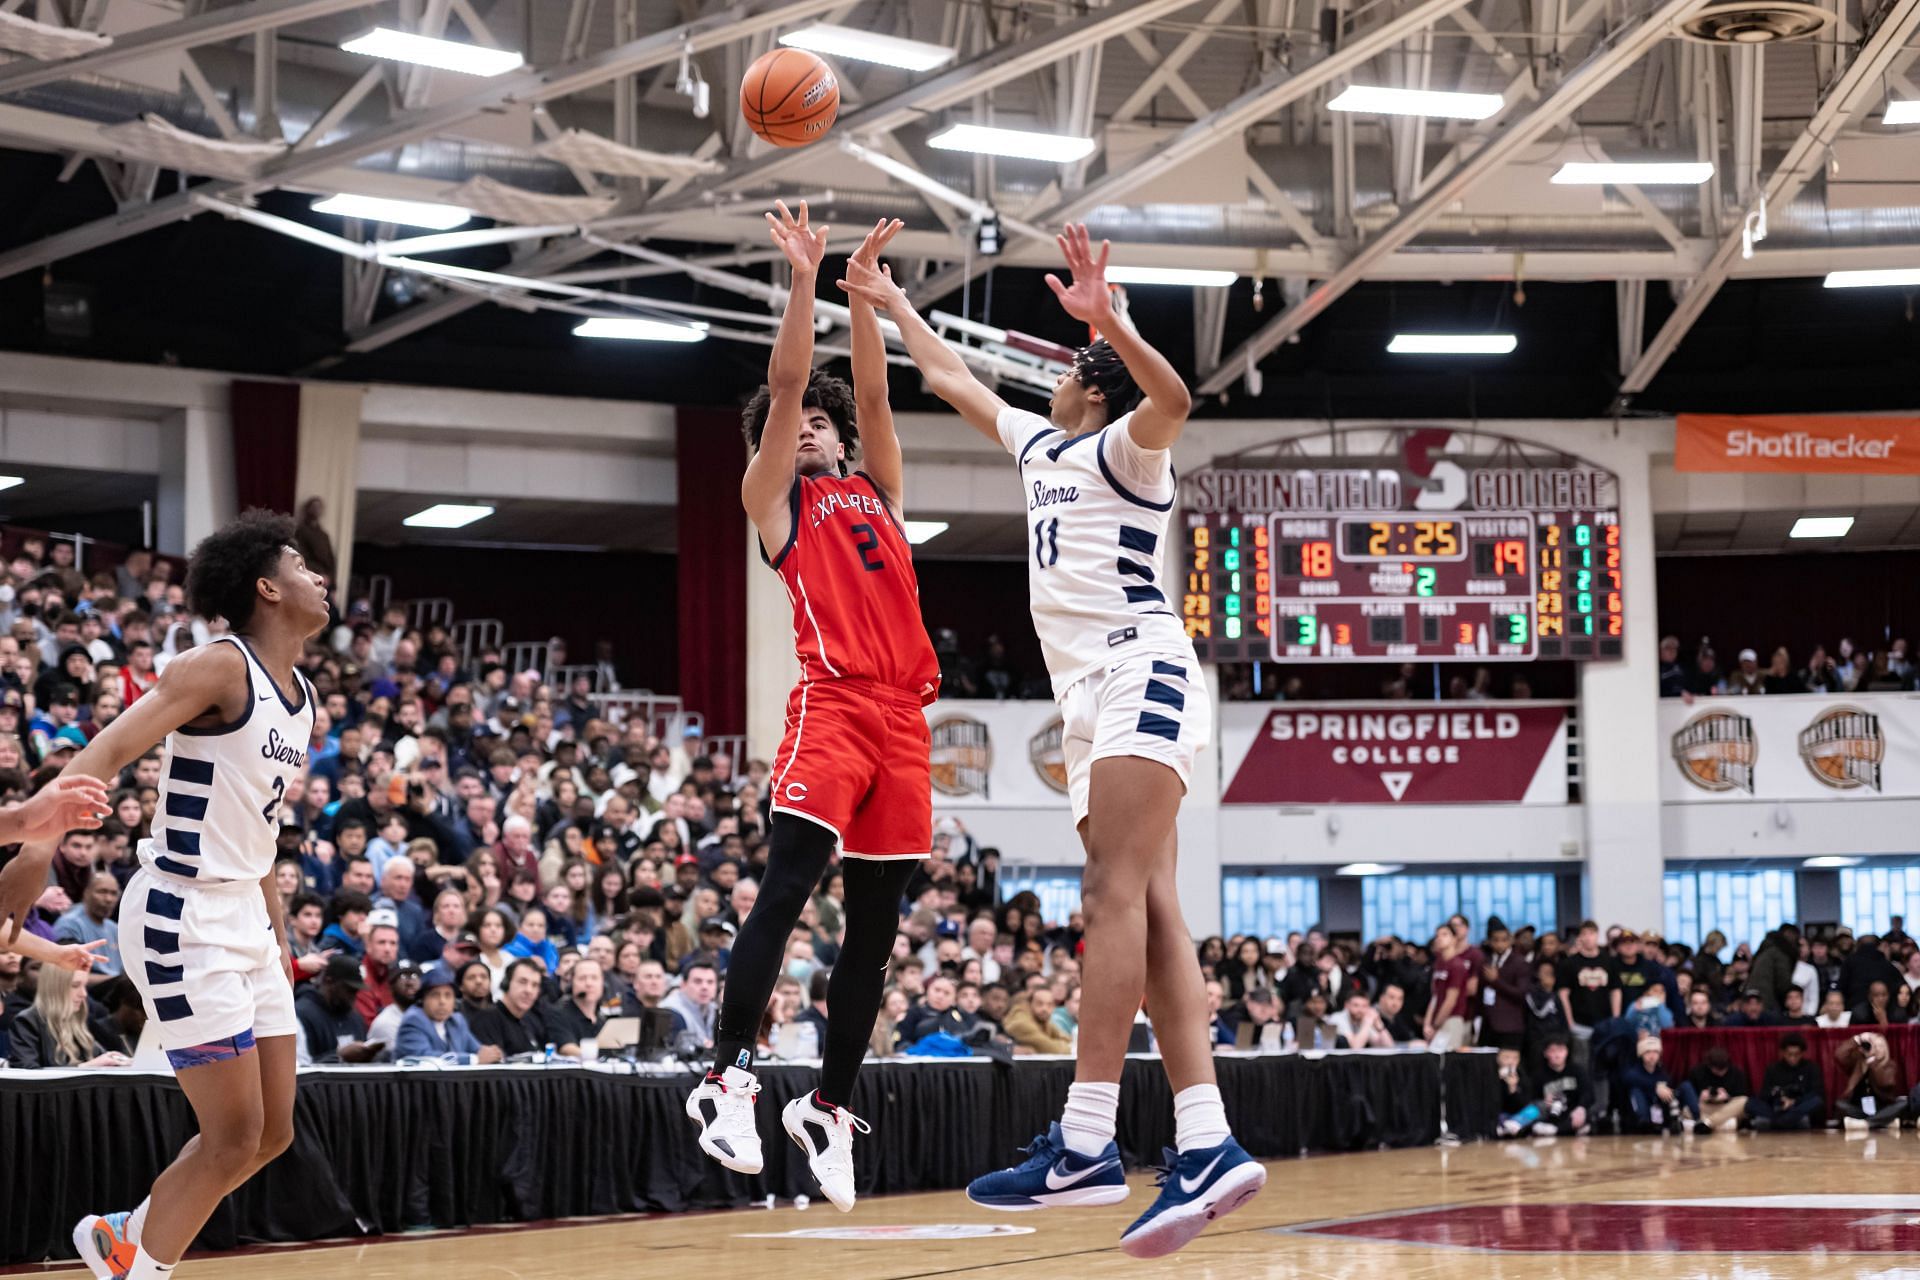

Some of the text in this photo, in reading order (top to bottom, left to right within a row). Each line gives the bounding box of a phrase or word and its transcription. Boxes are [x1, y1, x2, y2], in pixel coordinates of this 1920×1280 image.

[1726, 430, 1896, 458] ShotTracker
[1030, 480, 1079, 511] Sierra
[1193, 468, 1610, 513] SPRINGFIELD COLLEGE
[1369, 521, 1457, 556] 2:25
[1467, 519, 1529, 537] VISITOR
[1546, 525, 1560, 546] 2
[1575, 524, 1590, 546] 0
[1606, 525, 1620, 546] 2
[851, 523, 885, 571] 2
[1035, 517, 1058, 569] 11
[1195, 549, 1209, 570] 2
[1255, 549, 1269, 570] 5
[1301, 542, 1332, 577] 18
[1494, 541, 1525, 576] 19
[1541, 548, 1561, 568] 11
[1583, 548, 1591, 568] 1
[1606, 547, 1620, 568] 2
[1190, 571, 1210, 593] 11
[1256, 571, 1269, 593] 0
[1416, 567, 1436, 597] 2
[1542, 570, 1561, 591] 12
[1576, 570, 1591, 591] 2
[1607, 570, 1621, 590] 7
[1183, 594, 1210, 616] 23
[1256, 594, 1270, 616] 0
[1537, 592, 1562, 613] 23
[1577, 592, 1592, 613] 0
[1608, 592, 1622, 613] 6
[1184, 617, 1210, 639] 24
[1256, 617, 1270, 638] 4
[1298, 614, 1317, 645] 3
[1335, 623, 1350, 645] 3
[1459, 623, 1473, 644] 3
[1508, 613, 1528, 644] 3
[1538, 615, 1562, 636] 24
[1585, 615, 1593, 636] 1
[1609, 615, 1622, 636] 2
[1270, 714, 1520, 740] SPRINGFIELD
[1332, 746, 1460, 764] COLLEGE
[262, 776, 285, 825] 2
[786, 782, 808, 802] C
